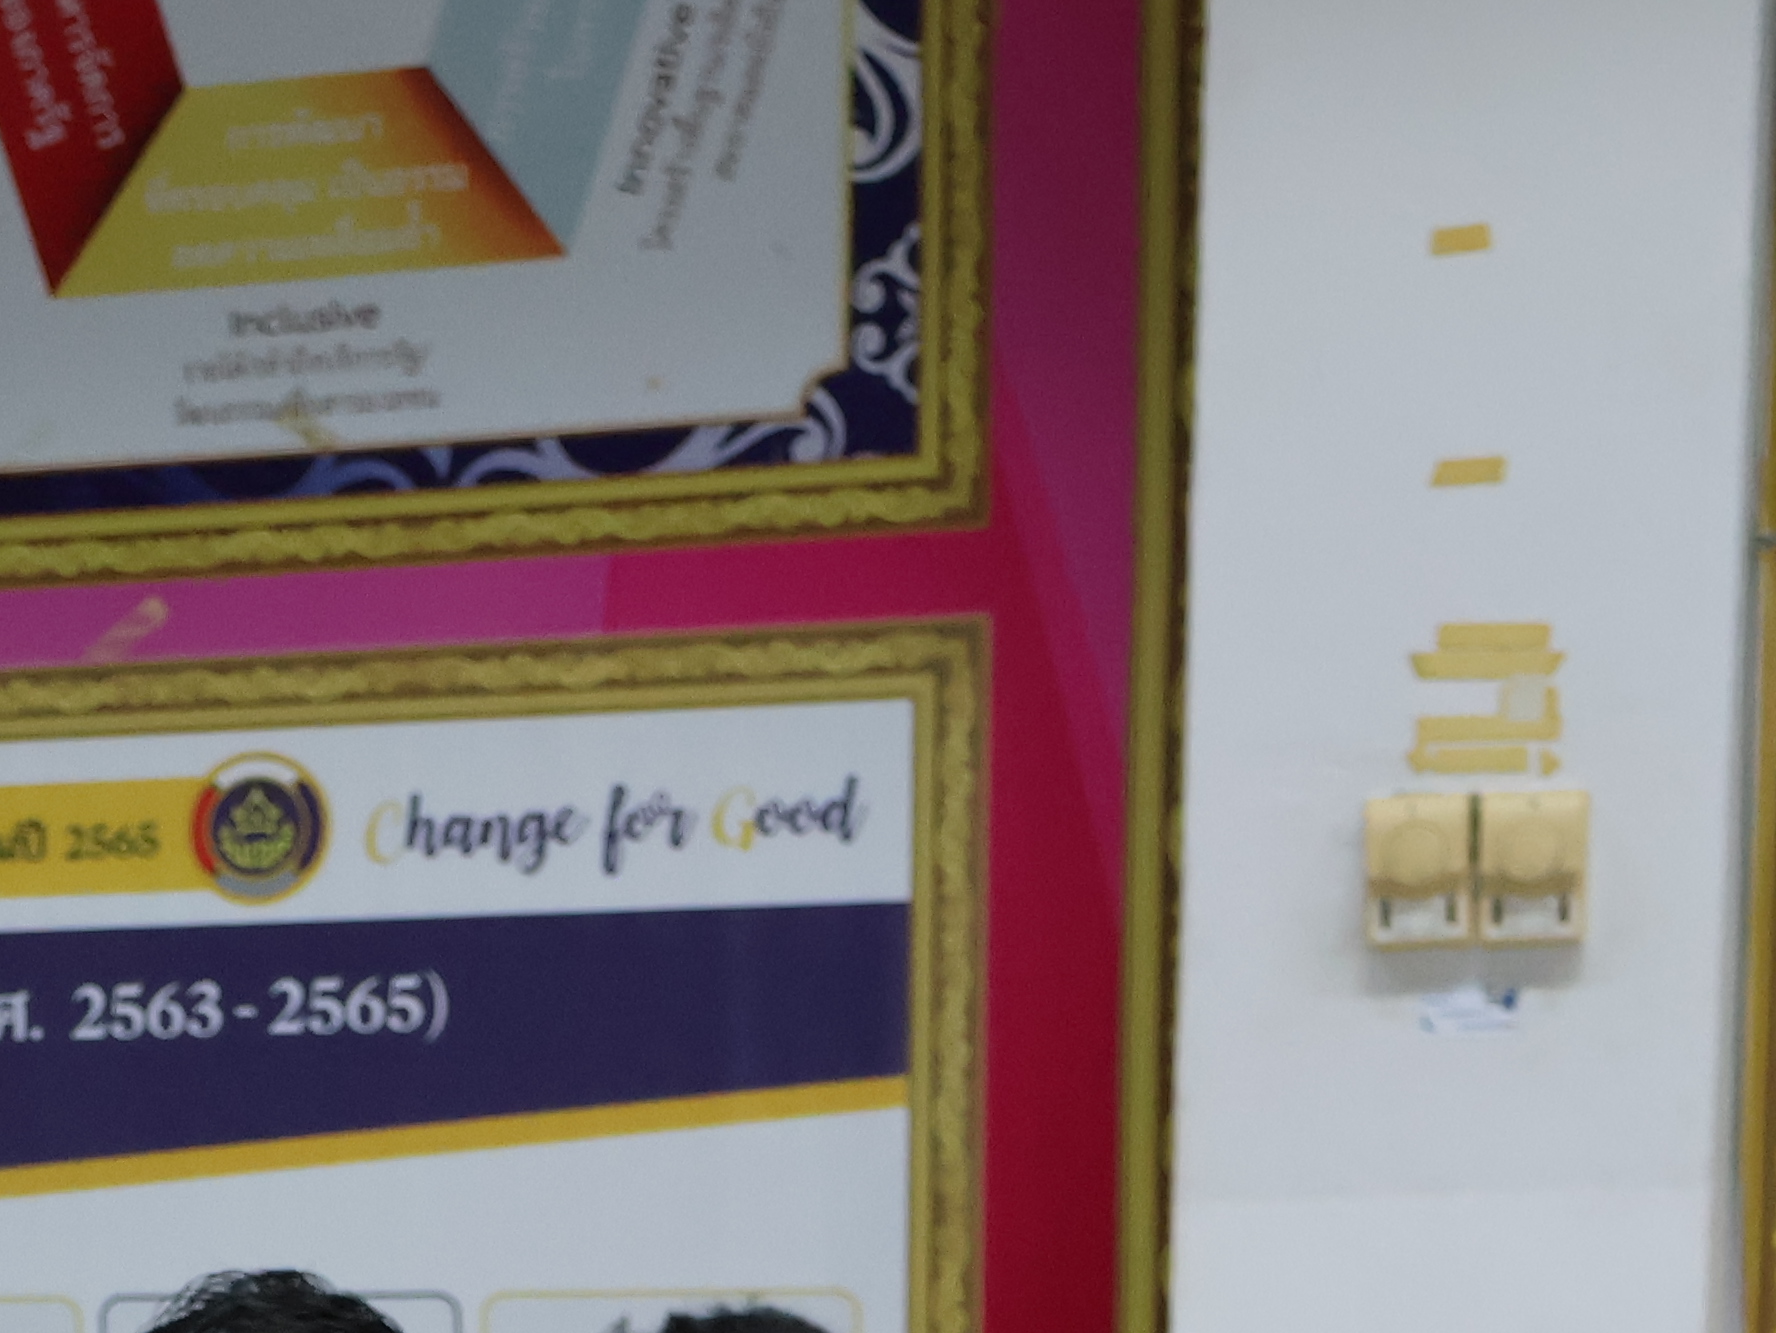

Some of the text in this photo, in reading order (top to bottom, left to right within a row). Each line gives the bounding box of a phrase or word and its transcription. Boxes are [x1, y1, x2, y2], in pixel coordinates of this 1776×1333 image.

[63, 817, 161, 862] 2565
[364, 775, 862, 876] Change for Good
